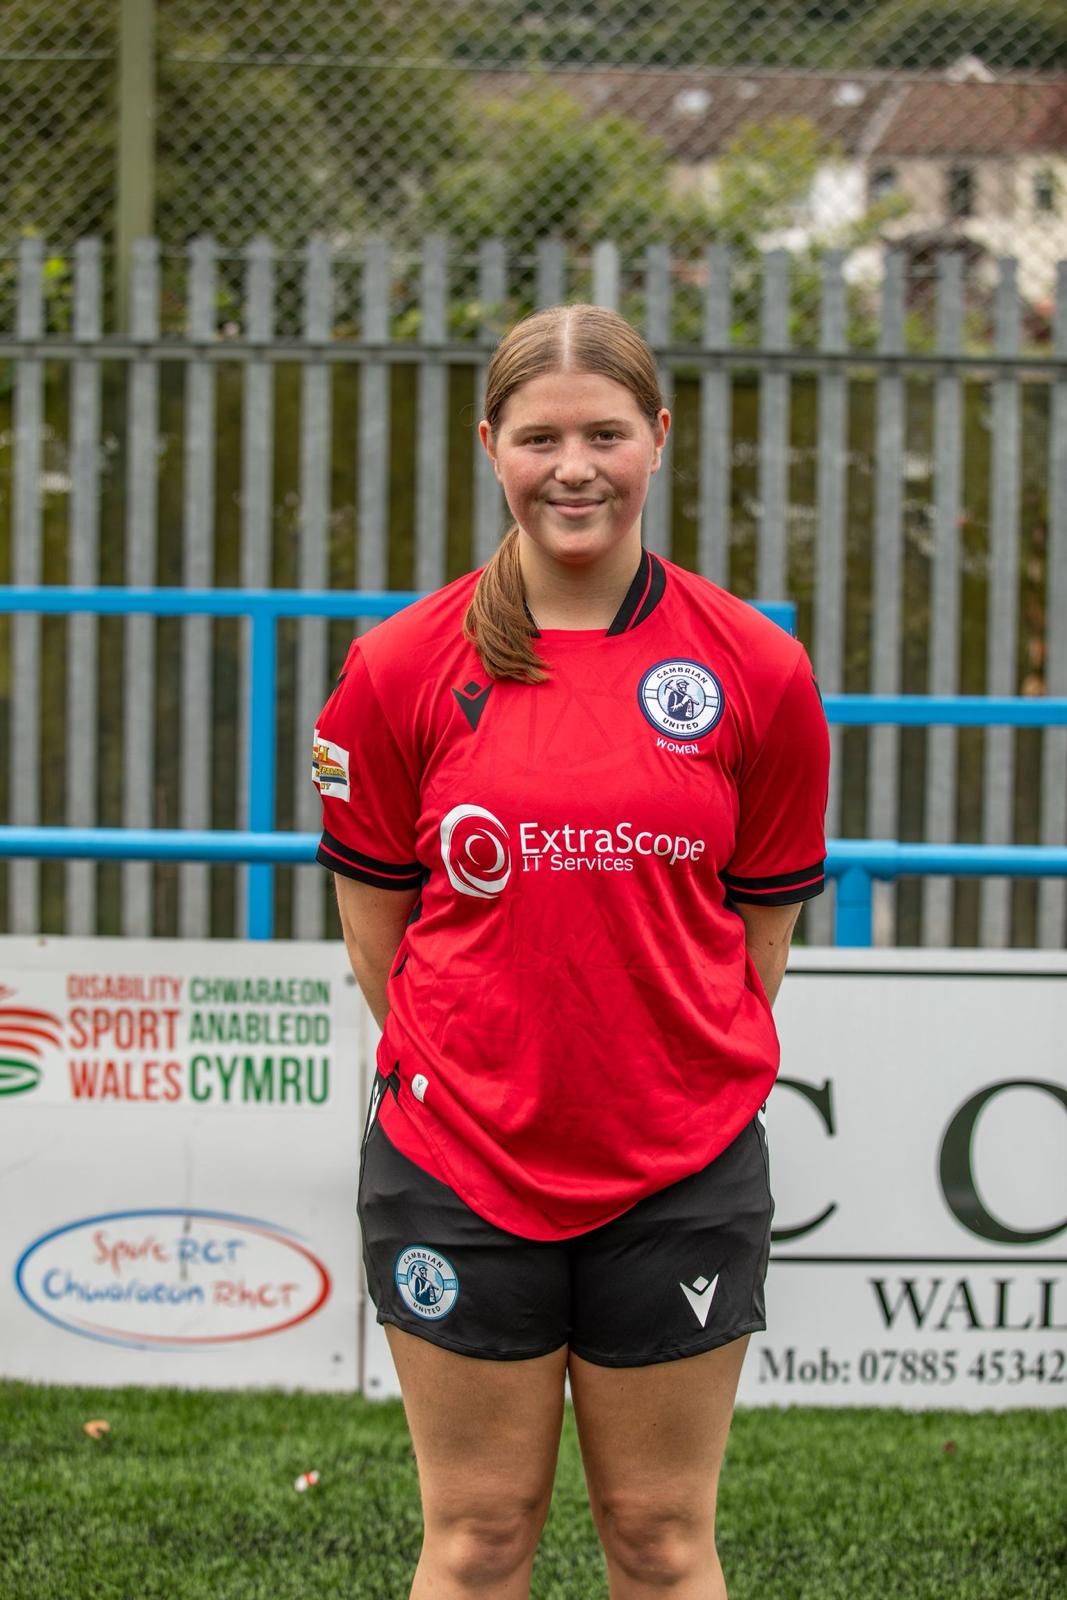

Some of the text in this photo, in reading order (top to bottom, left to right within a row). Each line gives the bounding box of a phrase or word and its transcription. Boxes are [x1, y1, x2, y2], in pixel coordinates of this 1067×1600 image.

[656, 667, 708, 684] CAMBRIAN
[662, 717, 699, 730] UNITED
[656, 738, 699, 754] WOMEN
[519, 822, 706, 865] ExtraScope
[522, 854, 634, 872] IT Services
[66, 974, 183, 1001] DISABILITY
[189, 976, 330, 1004] CHWARAEON
[68, 1008, 181, 1050] SPORT
[188, 1012, 330, 1046] ANABLEDD
[69, 1060, 182, 1101] WALES
[189, 1054, 330, 1105] CYMRU
[177, 1237, 246, 1264] RCT
[403, 1252, 443, 1268] CAMBRIAN
[212, 1279, 299, 1308] RhCT
[413, 1302, 441, 1314] UNITED
[758, 1347, 851, 1385] Mob:
[859, 1348, 959, 1385] 07885
